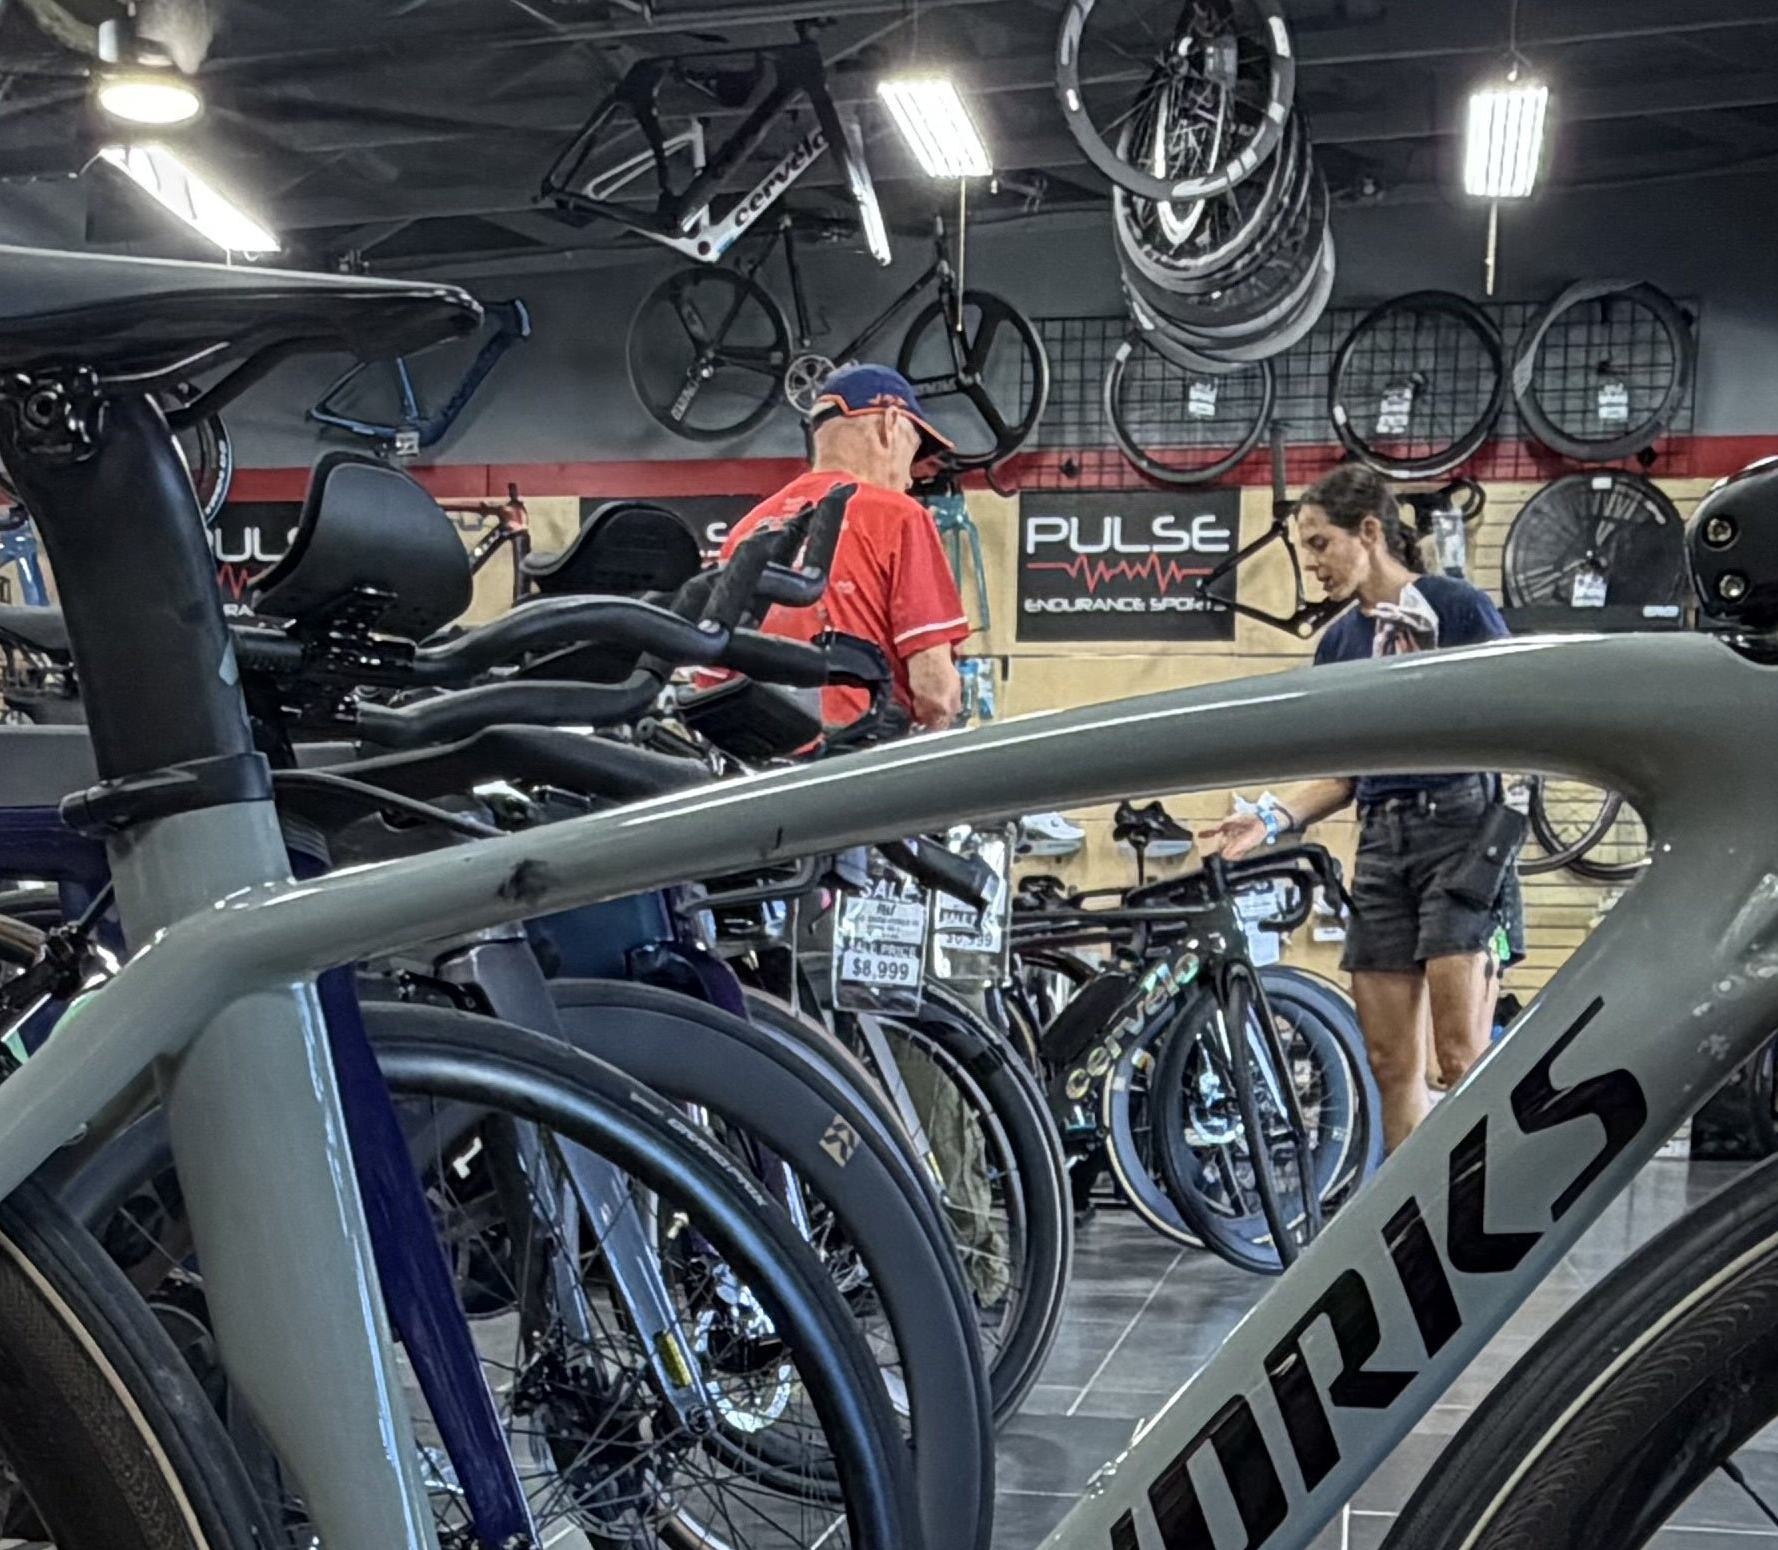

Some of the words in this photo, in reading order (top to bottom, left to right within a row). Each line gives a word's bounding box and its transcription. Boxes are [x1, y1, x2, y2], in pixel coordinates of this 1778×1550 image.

[1026, 514, 1231, 554] PULSE
[1024, 597, 1146, 613] ENDURANCE
[852, 957, 911, 981] $8,999
